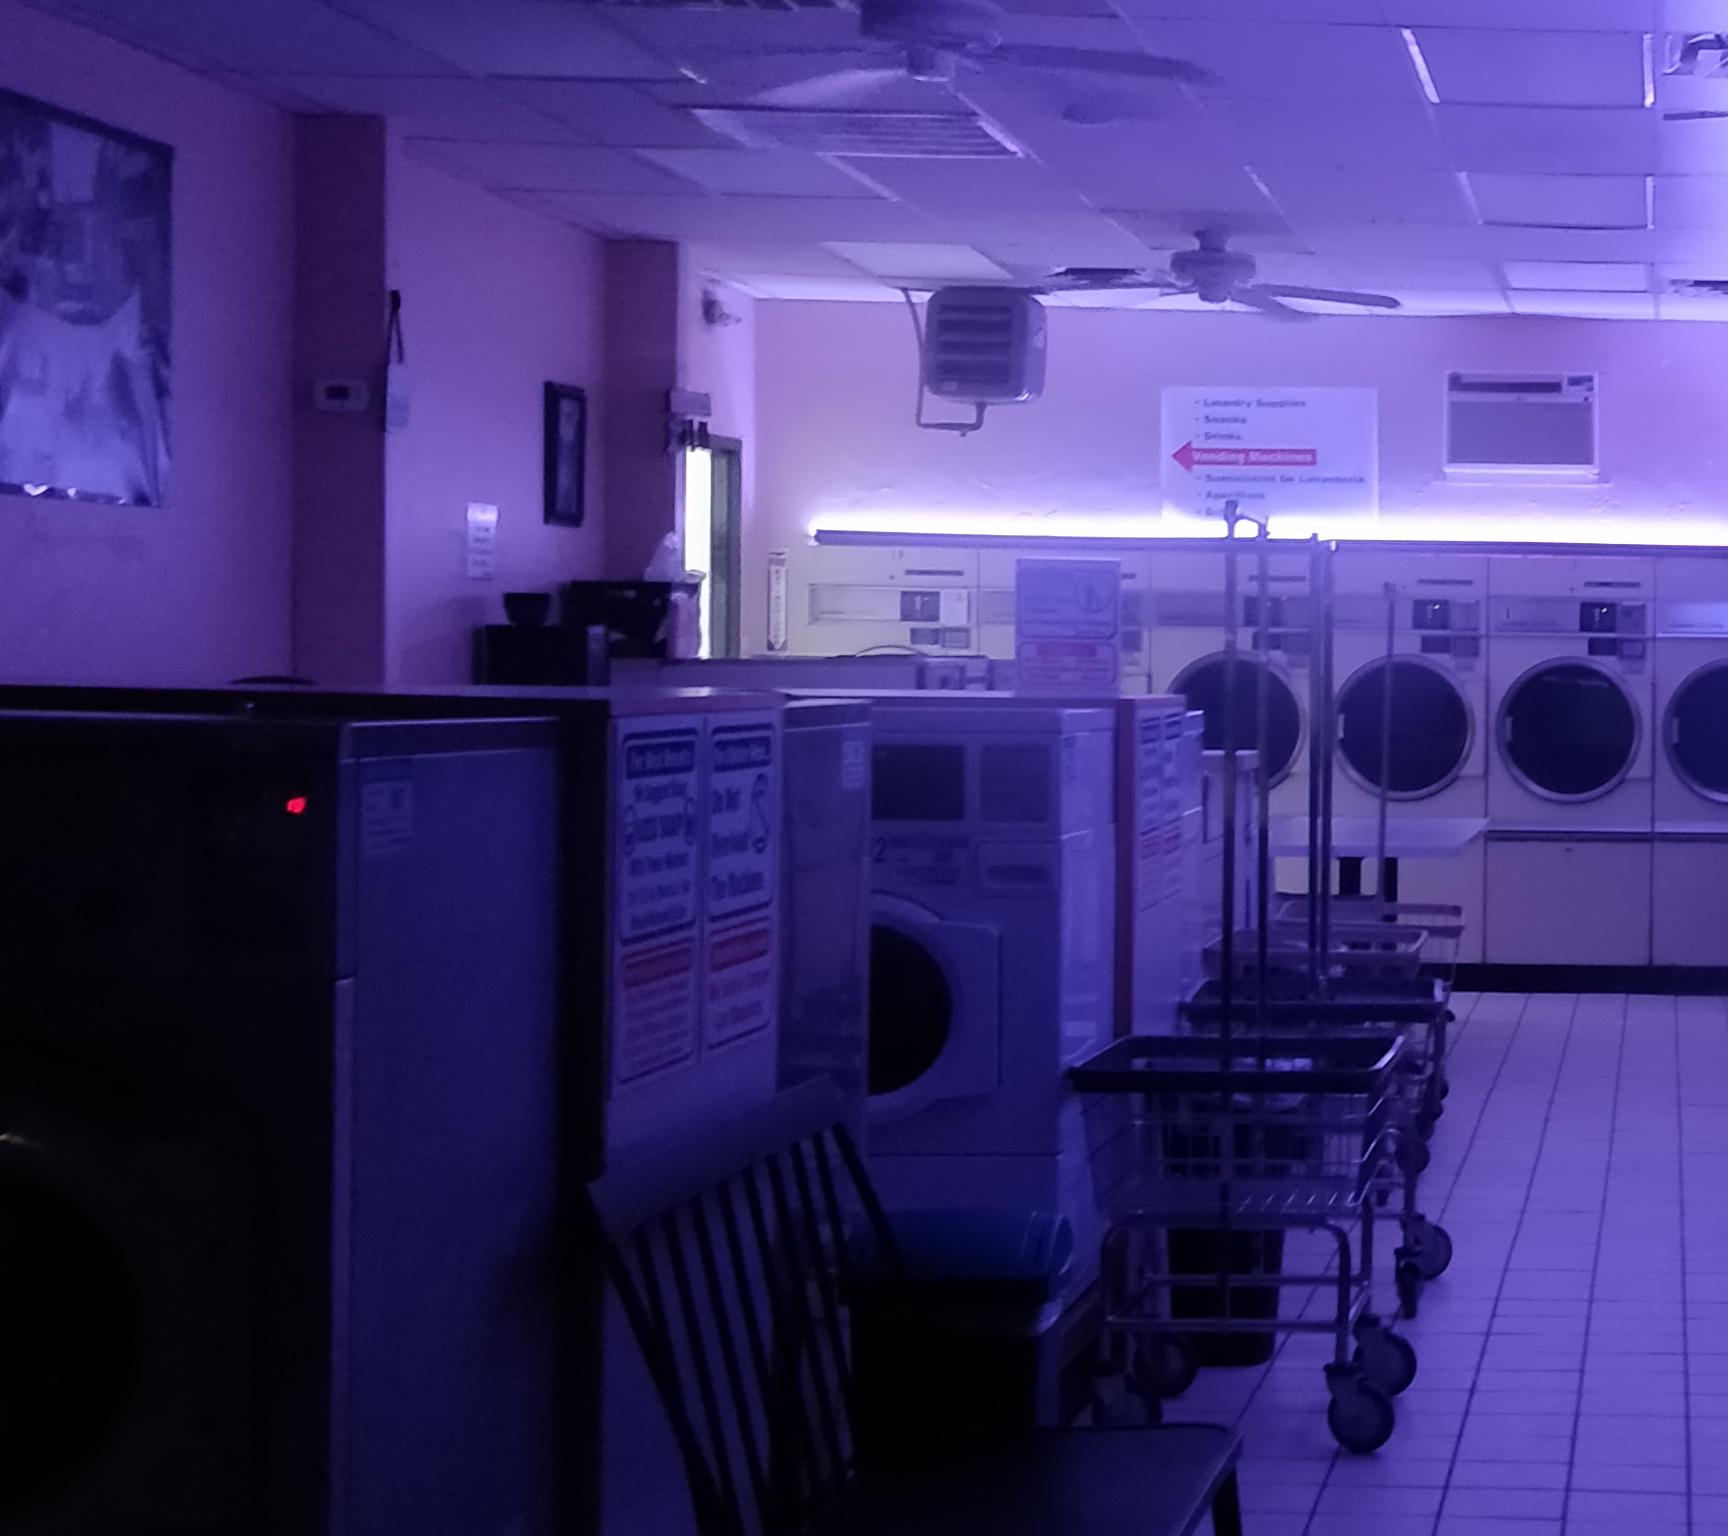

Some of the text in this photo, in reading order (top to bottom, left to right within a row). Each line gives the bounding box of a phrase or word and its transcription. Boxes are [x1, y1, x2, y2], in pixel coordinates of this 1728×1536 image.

[1203, 398, 1252, 409] Laundry
[1193, 450, 1313, 465] Vending Machines
